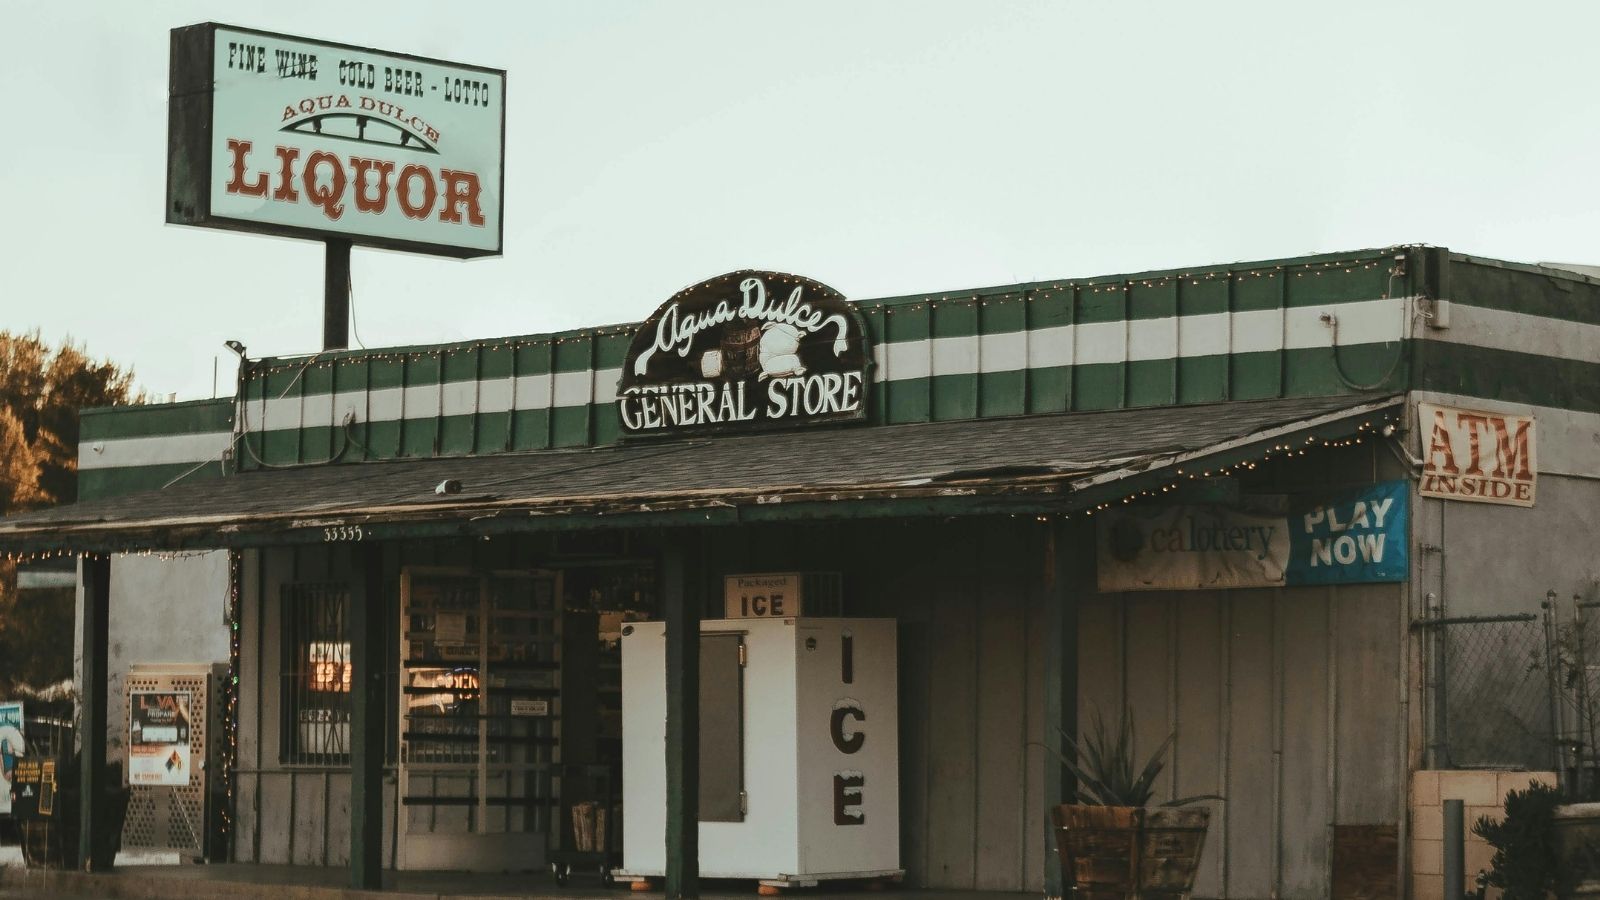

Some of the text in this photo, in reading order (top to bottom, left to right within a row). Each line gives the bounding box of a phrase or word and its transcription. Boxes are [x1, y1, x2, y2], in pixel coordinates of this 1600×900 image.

[228, 42, 266, 73] FINE
[275, 49, 318, 80] WINE
[338, 59, 375, 89] COLD
[384, 66, 424, 97] BEER
[444, 76, 489, 108] LOTTO
[281, 95, 441, 144] AQUA DULCE
[226, 138, 486, 228] LIQUOR
[634, 278, 848, 377] Agua Dulce
[620, 371, 862, 430] GENERAL STORE
[1424, 410, 1533, 481] ATM
[1422, 474, 1532, 502] INSIDE
[1304, 497, 1394, 535] PLAY
[1310, 532, 1387, 568] NOW
[737, 577, 788, 589] Packaged
[741, 594, 784, 617] ICE
[829, 628, 866, 827] ICE
